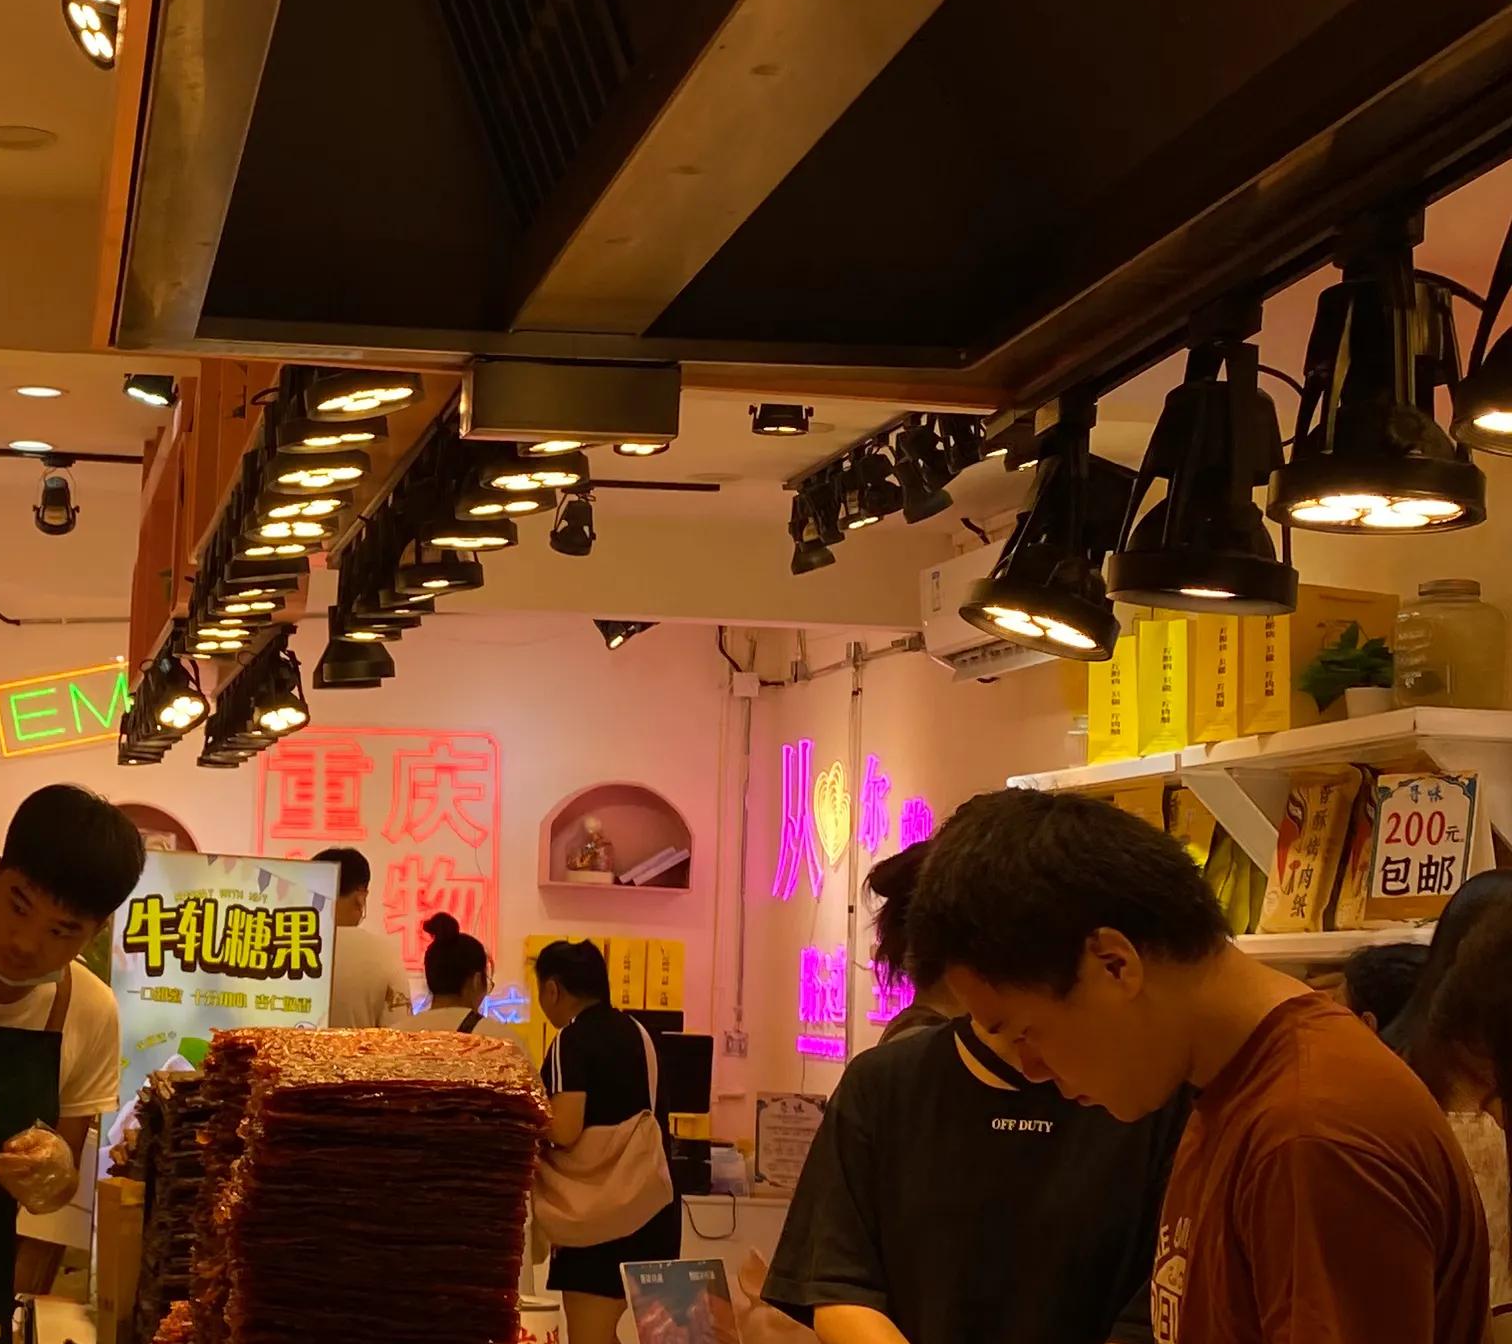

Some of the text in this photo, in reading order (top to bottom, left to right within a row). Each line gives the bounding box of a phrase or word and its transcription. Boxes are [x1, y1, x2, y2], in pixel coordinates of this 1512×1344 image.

[267, 738, 489, 848] 重庆
[1380, 854, 1456, 897] 包邮
[124, 894, 322, 979] 牛轧糖果
[991, 1118, 1054, 1133] OFF DUTY
